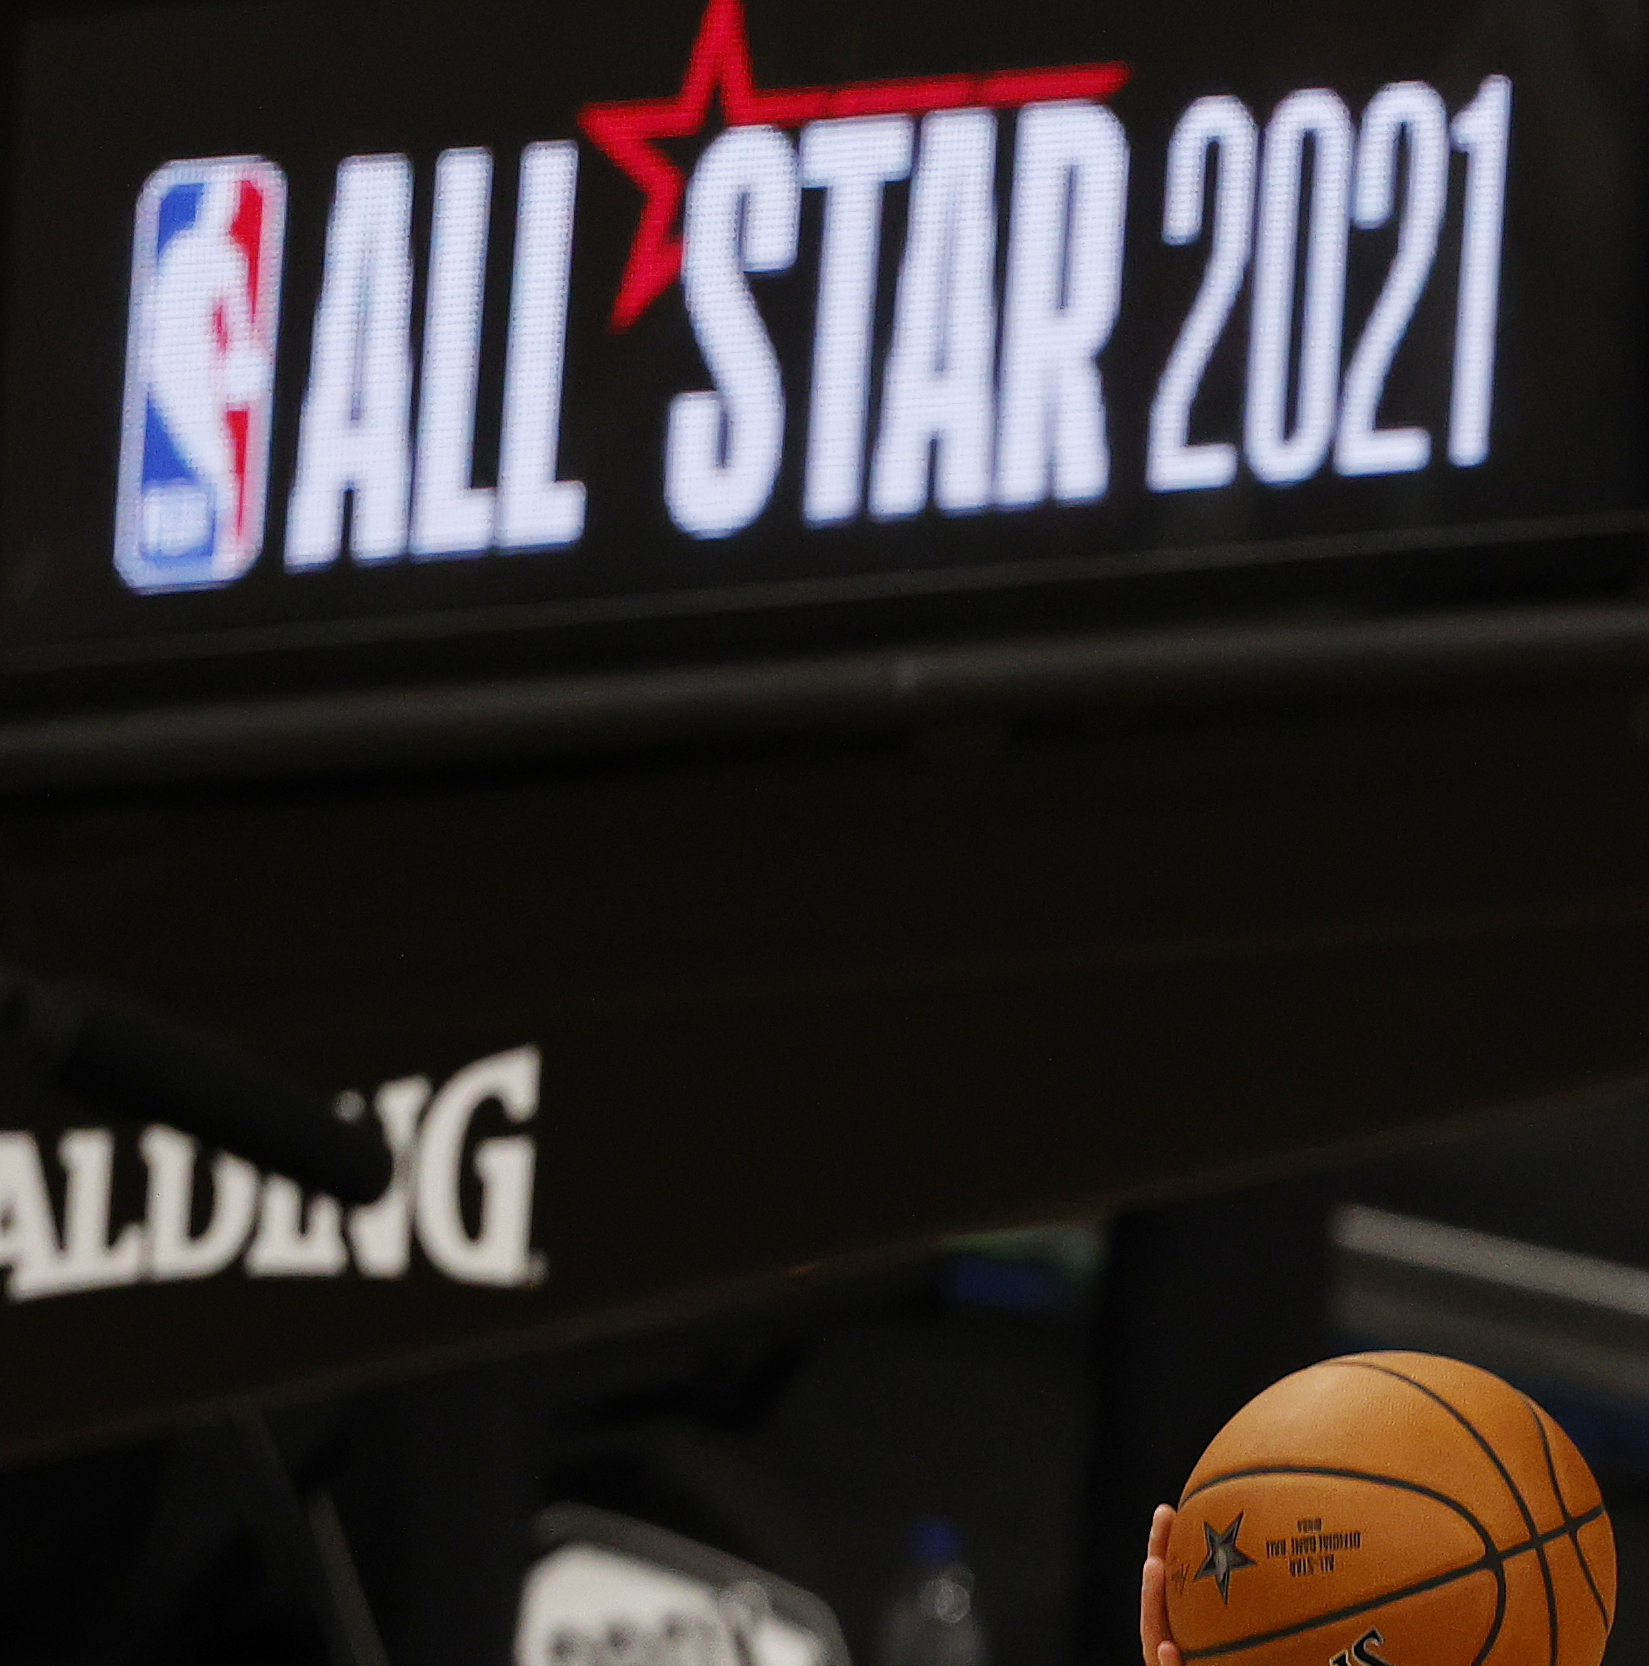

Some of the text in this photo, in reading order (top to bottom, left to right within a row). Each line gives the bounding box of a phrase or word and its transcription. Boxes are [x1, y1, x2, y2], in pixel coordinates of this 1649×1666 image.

[284, 73, 1513, 568] ALL STAR 2021
